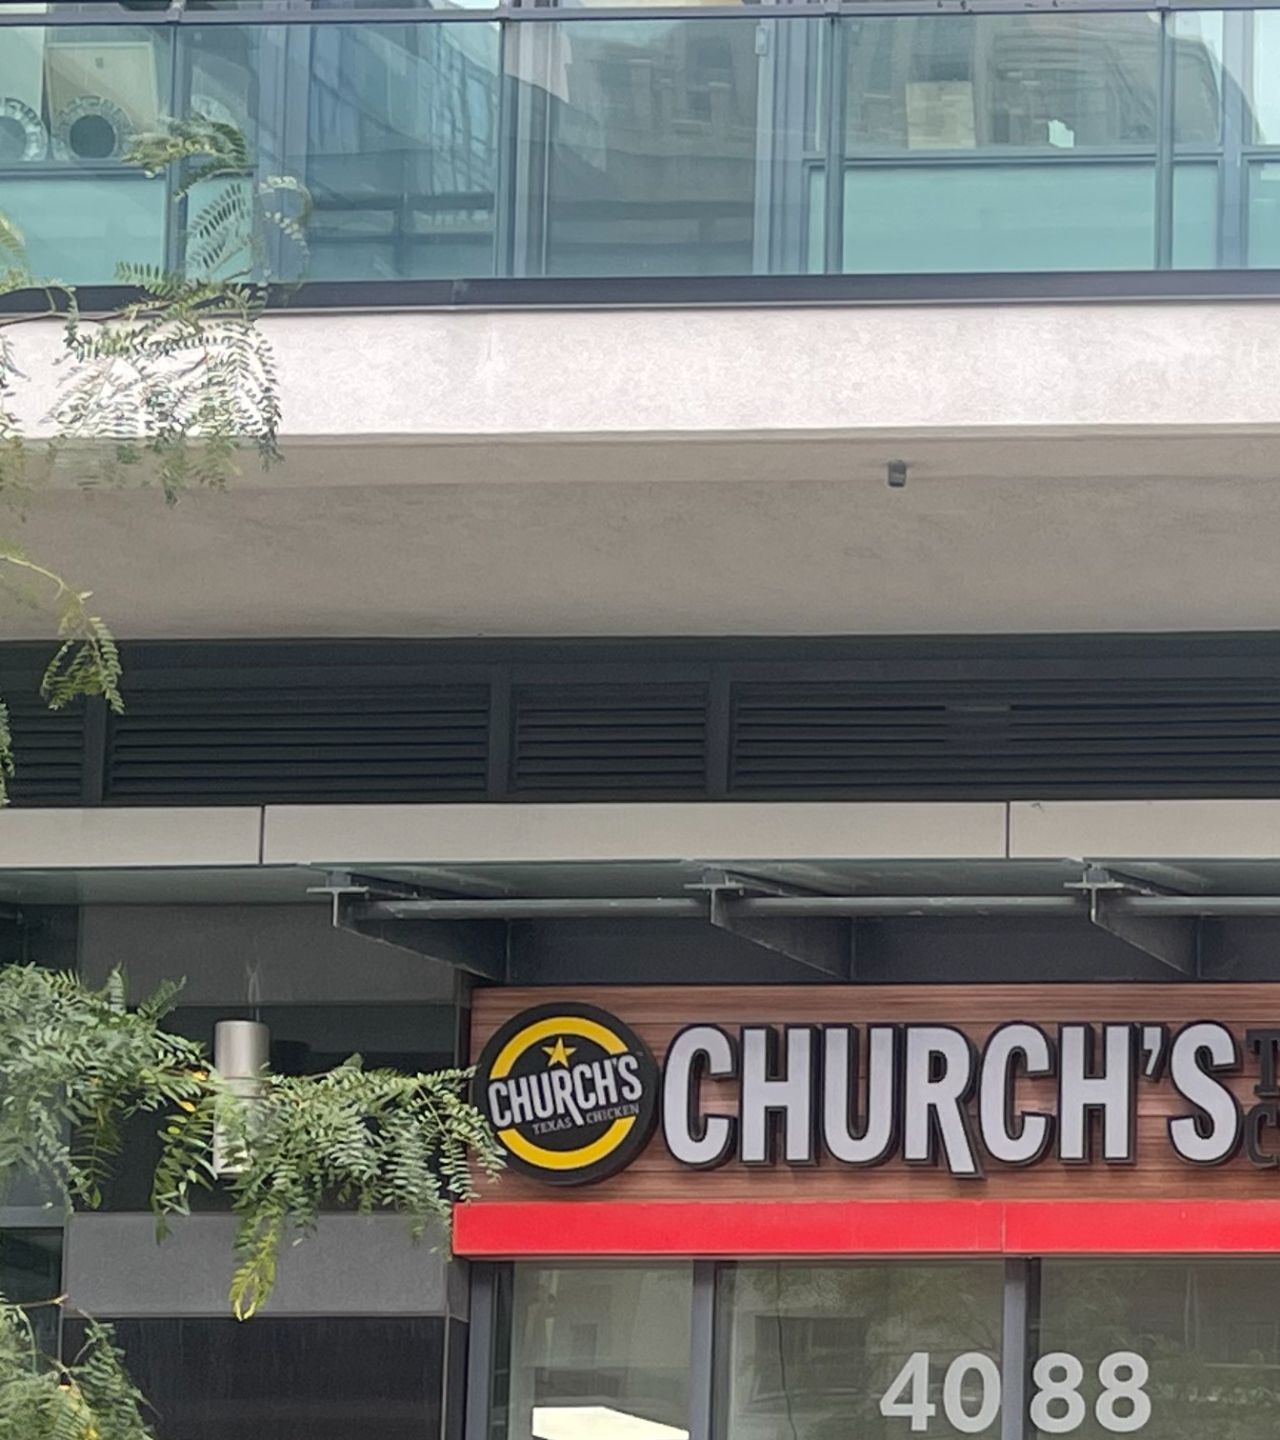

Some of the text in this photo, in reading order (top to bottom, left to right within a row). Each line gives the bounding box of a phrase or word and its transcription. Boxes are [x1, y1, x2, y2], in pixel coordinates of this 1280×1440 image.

[488, 1054, 643, 1128] CHURCH'S
[532, 1103, 640, 1136] TEXAS CHICKEN
[662, 1020, 1242, 1177] CHURCH'S
[879, 1351, 1152, 1434] 4088
